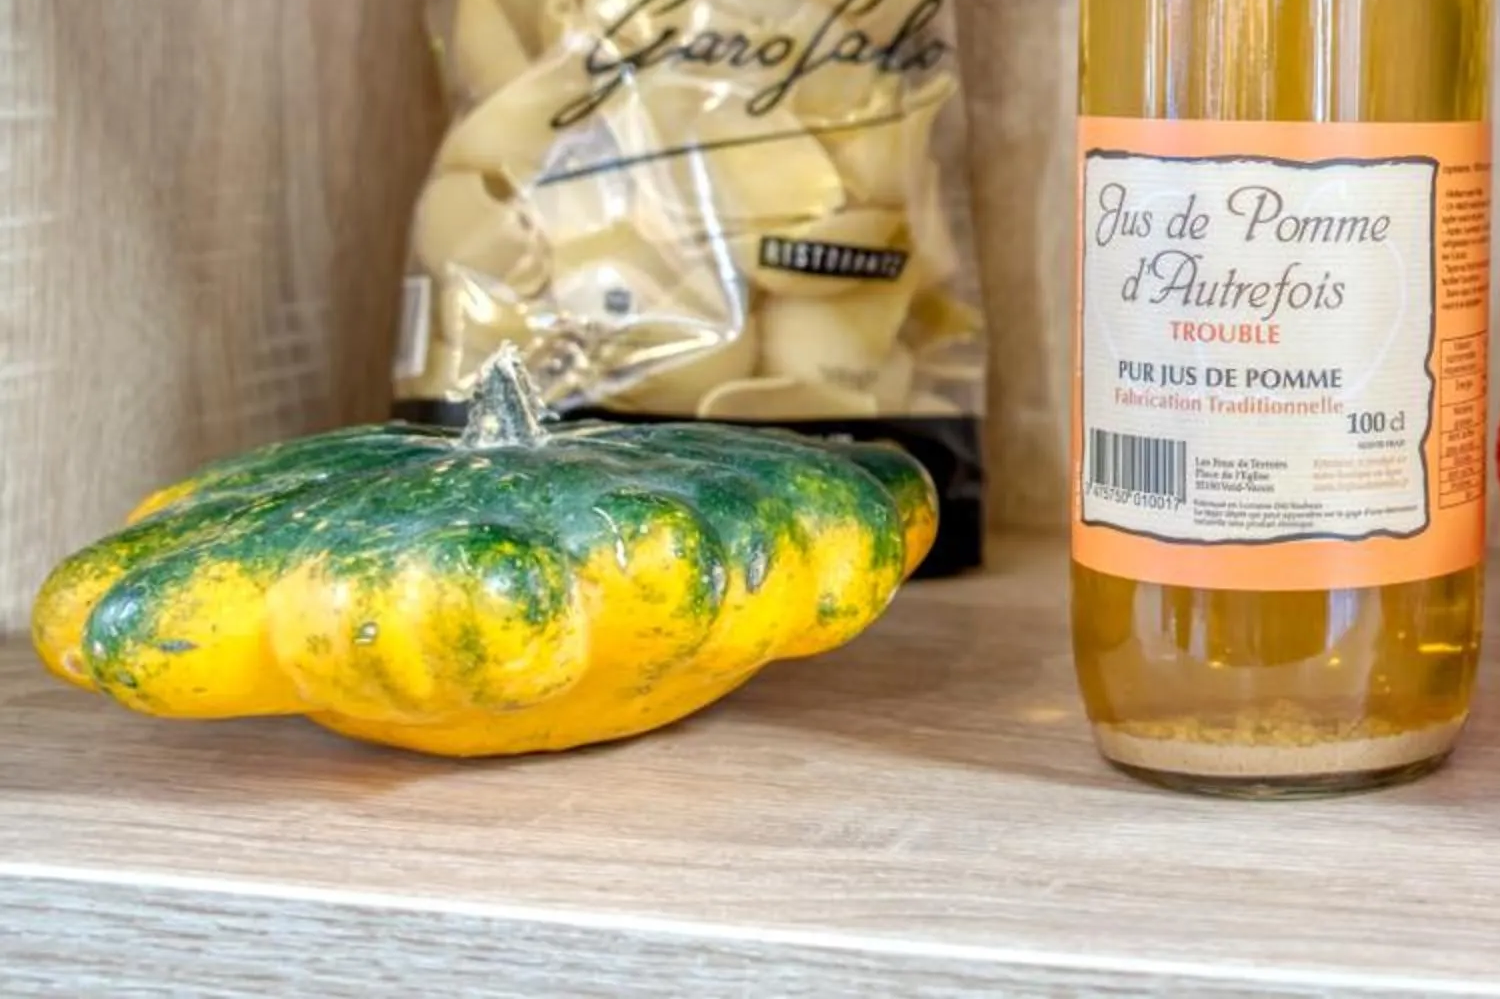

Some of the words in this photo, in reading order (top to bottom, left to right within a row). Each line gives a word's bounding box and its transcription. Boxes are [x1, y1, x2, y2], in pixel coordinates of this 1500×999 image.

[1096, 182, 1152, 246] Jus
[1167, 193, 1210, 240] de
[1226, 185, 1391, 243] Pomme
[1121, 249, 1345, 321] d'Autrefois
[1170, 321, 1281, 344] TROUBLE
[1118, 359, 1155, 383] PUR
[1160, 364, 1198, 387] JUS
[1205, 367, 1237, 388] DE
[1246, 368, 1343, 389] POMME
[1113, 386, 1202, 412] Fabrication
[1208, 395, 1344, 416] Traditionnelle
[1346, 411, 1386, 434] 100
[1389, 410, 1405, 432] cl
